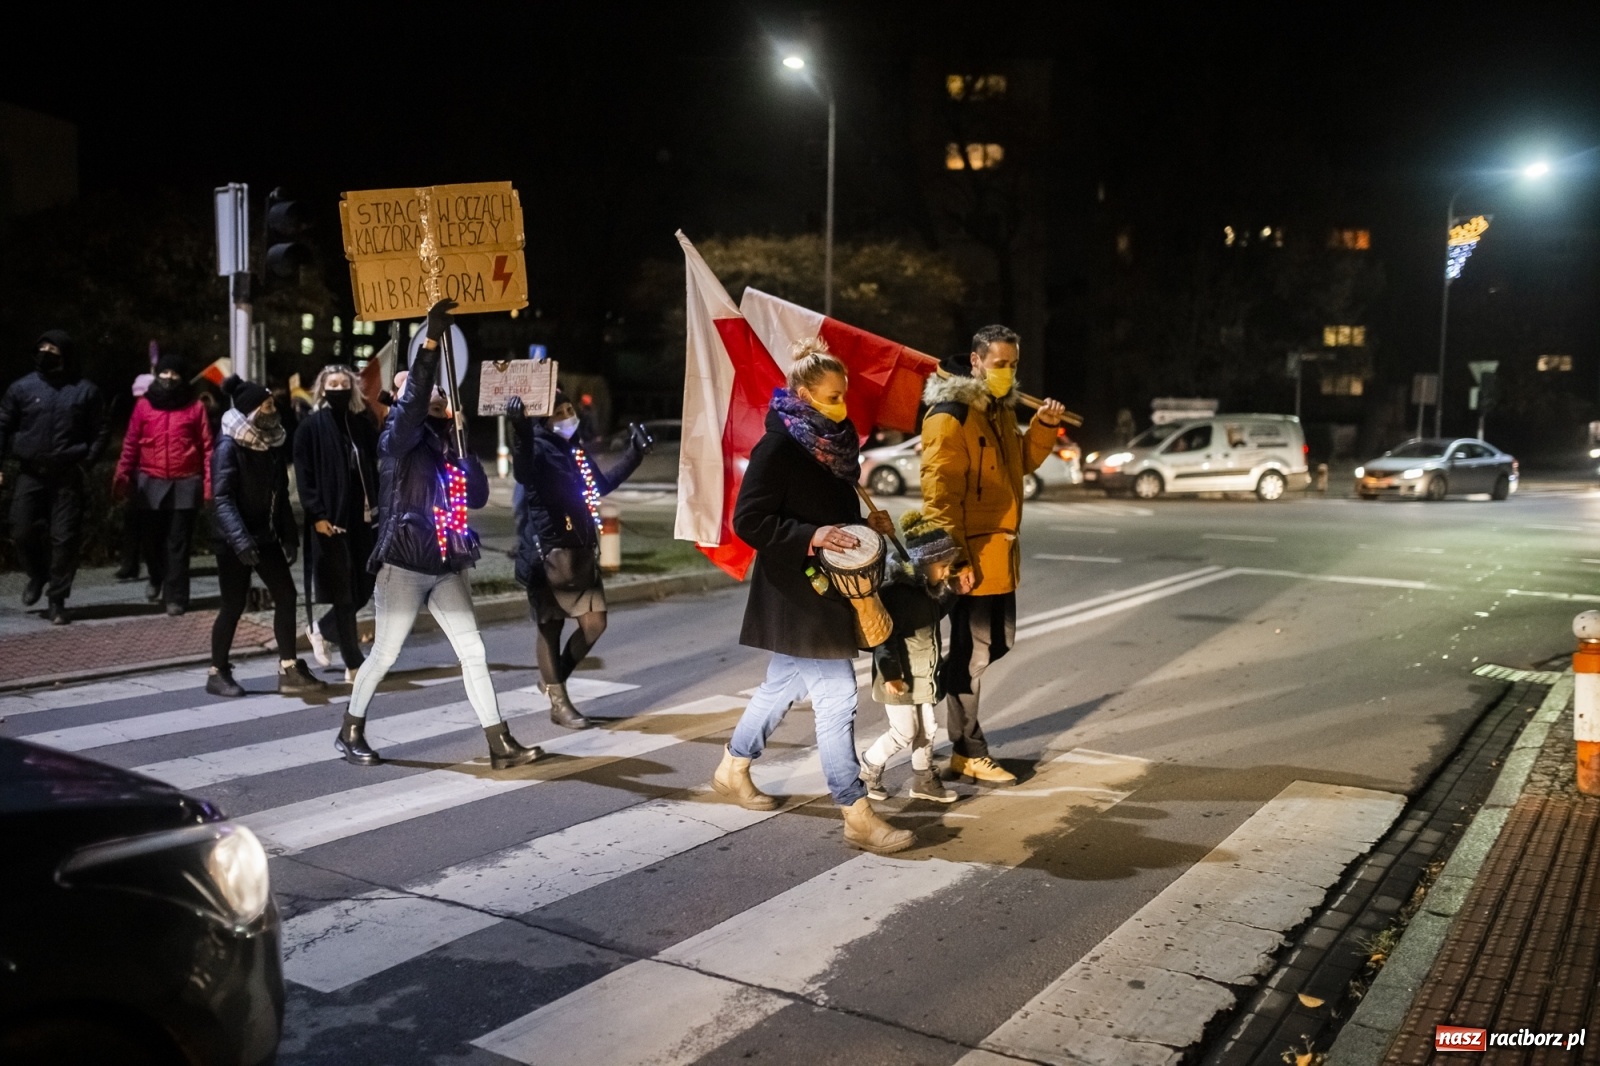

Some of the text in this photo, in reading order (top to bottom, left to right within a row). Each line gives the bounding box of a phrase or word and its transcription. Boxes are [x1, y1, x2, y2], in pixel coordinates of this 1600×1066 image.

[357, 194, 514, 225] STRACH W OCZACH
[355, 221, 501, 256] KACZORA LEPSZY
[420, 256, 446, 275] OD
[361, 272, 486, 313] WIBRATORA
[494, 386, 504, 395] DO
